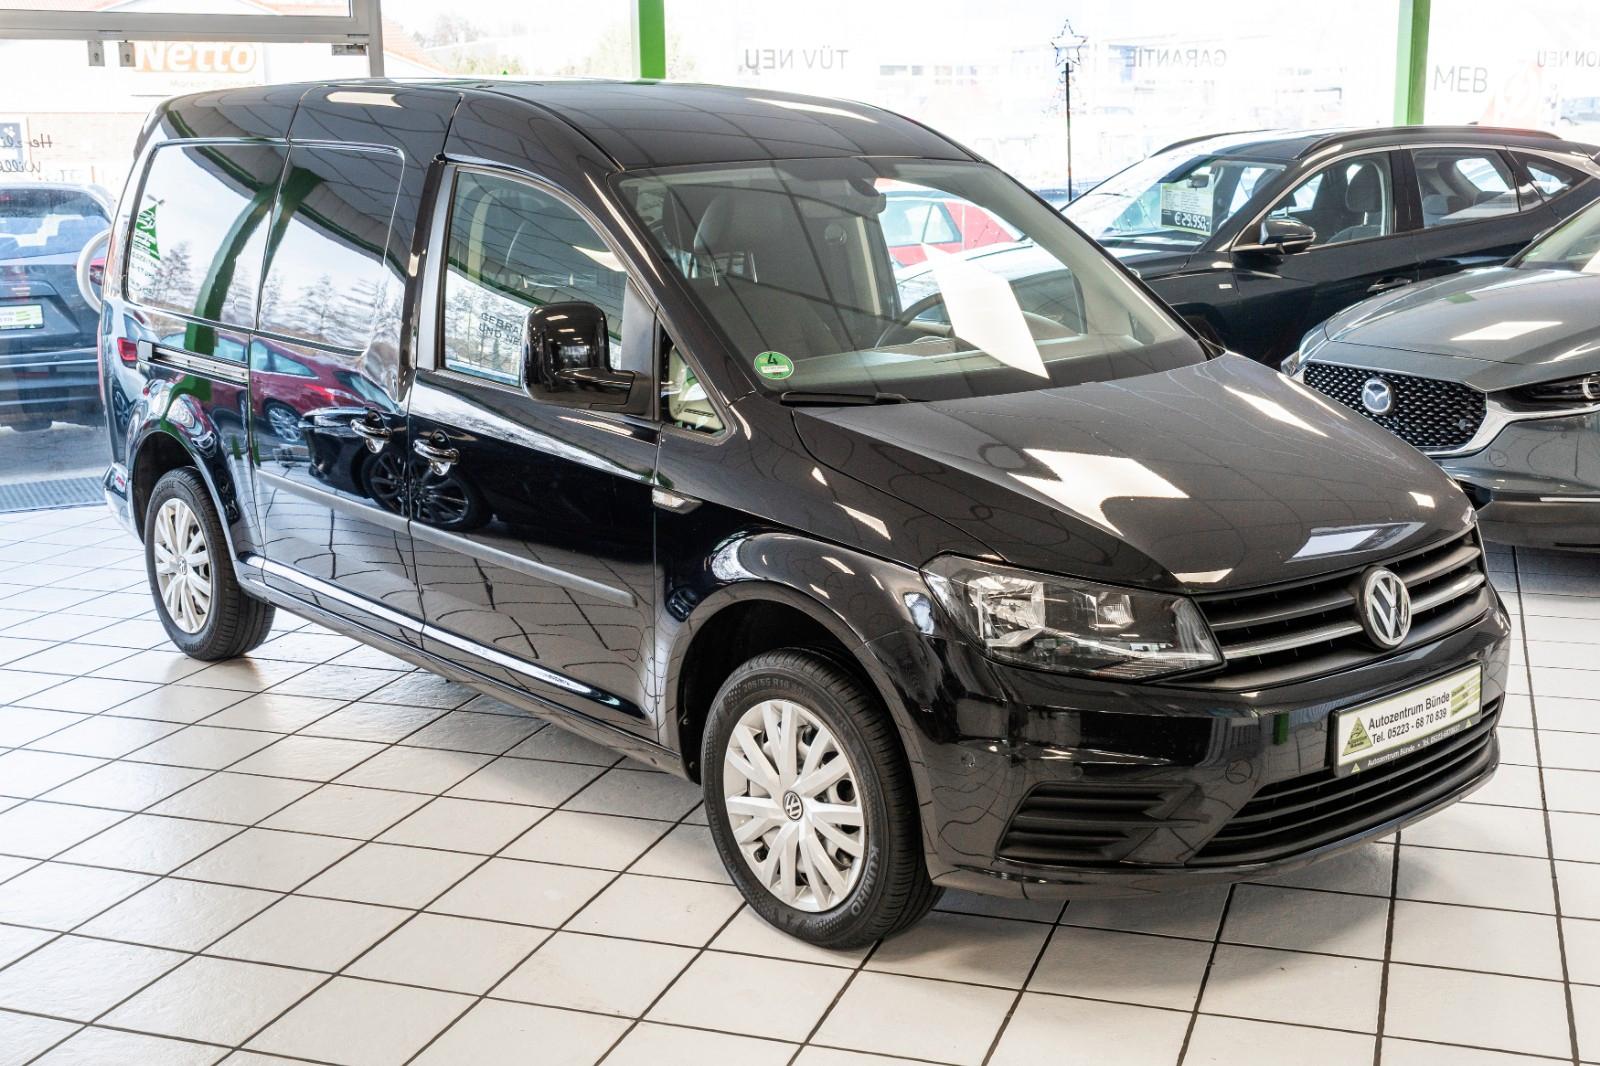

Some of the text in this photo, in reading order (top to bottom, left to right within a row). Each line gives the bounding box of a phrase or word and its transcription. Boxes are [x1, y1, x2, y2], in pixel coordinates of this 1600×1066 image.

[134, 42, 257, 73] Netto
[1433, 64, 1488, 94] MEB
[767, 353, 779, 365] 4
[1368, 702, 1424, 730] Autozentrum
[1425, 691, 1450, 710] Bünde
[1372, 729, 1386, 745] Tel.
[1387, 722, 1410, 740] 05223
[1416, 716, 1425, 729] 68
[1426, 712, 1434, 725] 70
[1435, 707, 1447, 721] 839
[1367, 749, 1400, 768] Autozentrum
[851, 845, 881, 916] KUMHO
